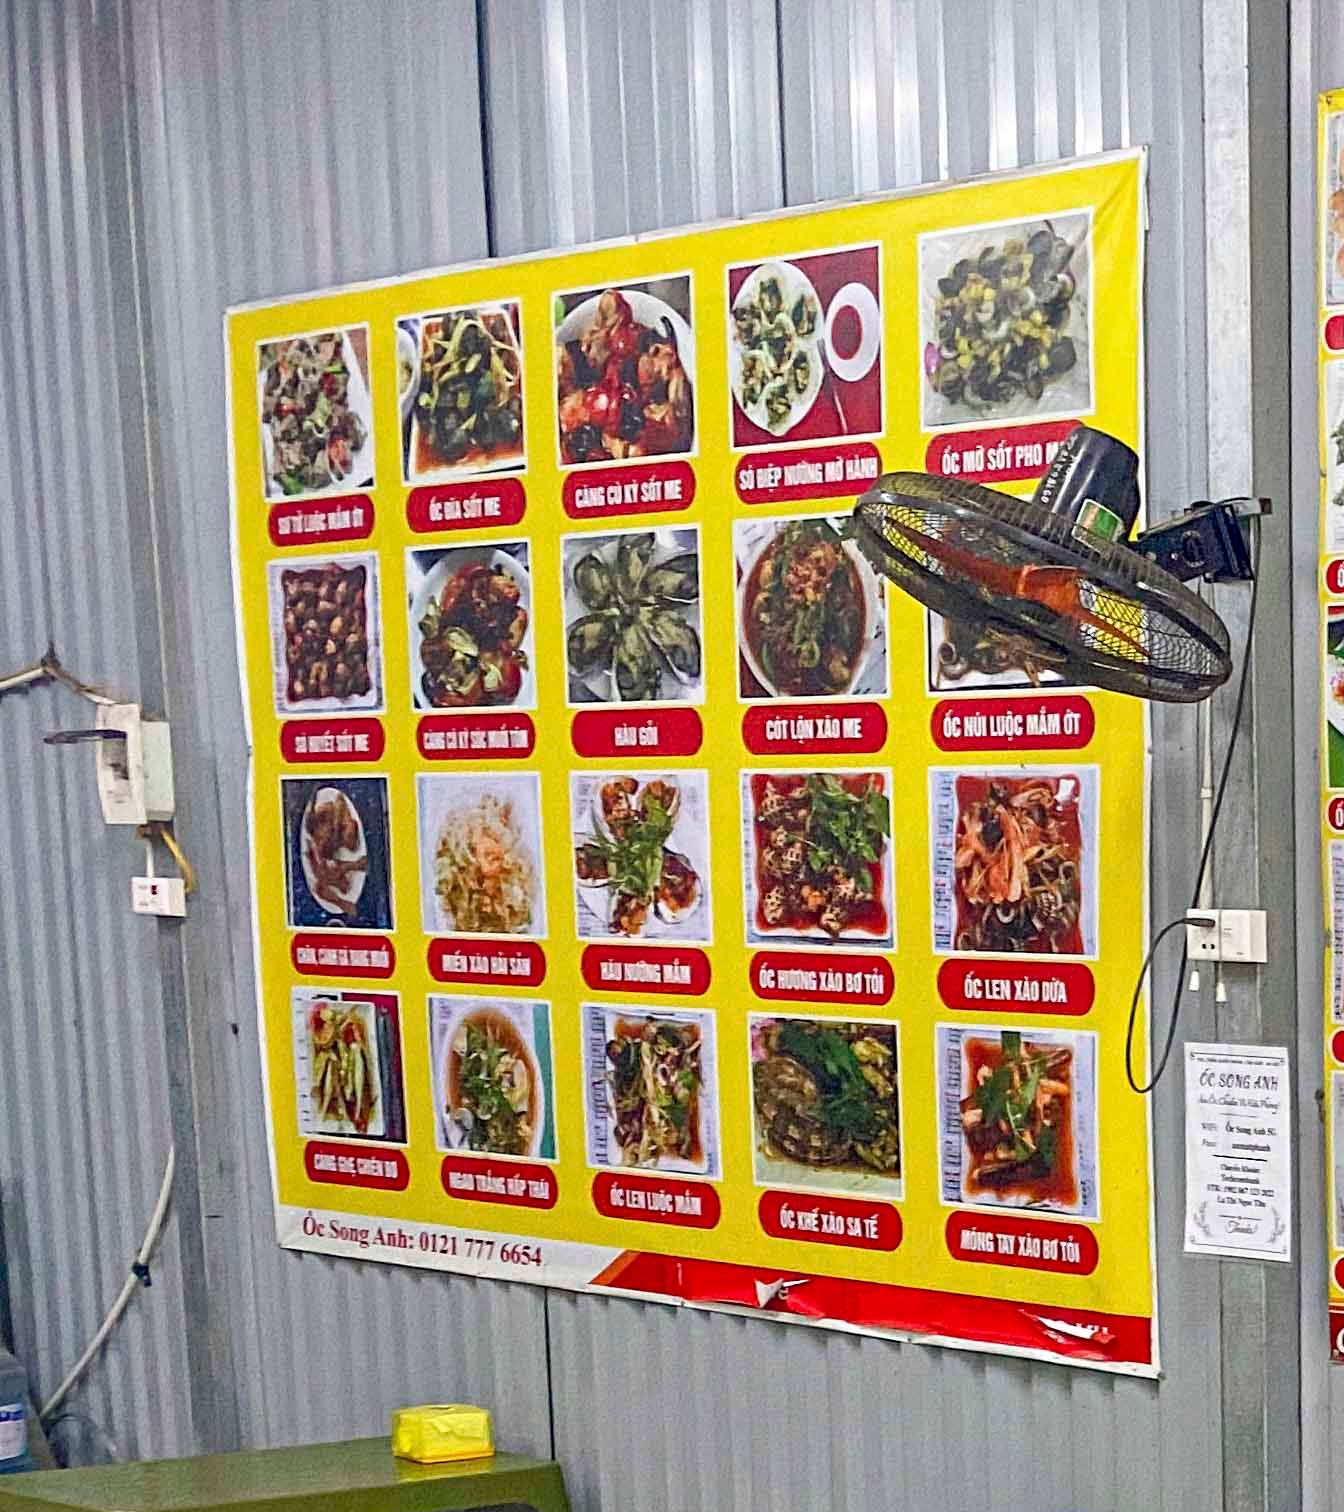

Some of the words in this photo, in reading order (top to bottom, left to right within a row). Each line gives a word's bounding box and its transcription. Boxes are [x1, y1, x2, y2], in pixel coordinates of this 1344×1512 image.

[964, 971, 982, 998] ỐC
[984, 979, 1010, 999] LEN
[1014, 976, 1039, 1001] XÀO
[1042, 977, 1066, 1002] DỪA
[1219, 1073, 1250, 1089] SONG
[1253, 1076, 1279, 1091] ANH
[780, 1203, 795, 1228] ỐC
[796, 1206, 818, 1231] KHẾ
[820, 1210, 844, 1234] XÀO
[846, 1217, 861, 1236] SA
[863, 1213, 878, 1238] TẾ
[329, 1219, 370, 1249] Song
[372, 1226, 414, 1249] Anh:
[419, 1232, 457, 1256] 0121
[464, 1238, 495, 1260] 777
[500, 1242, 542, 1267] 6654
